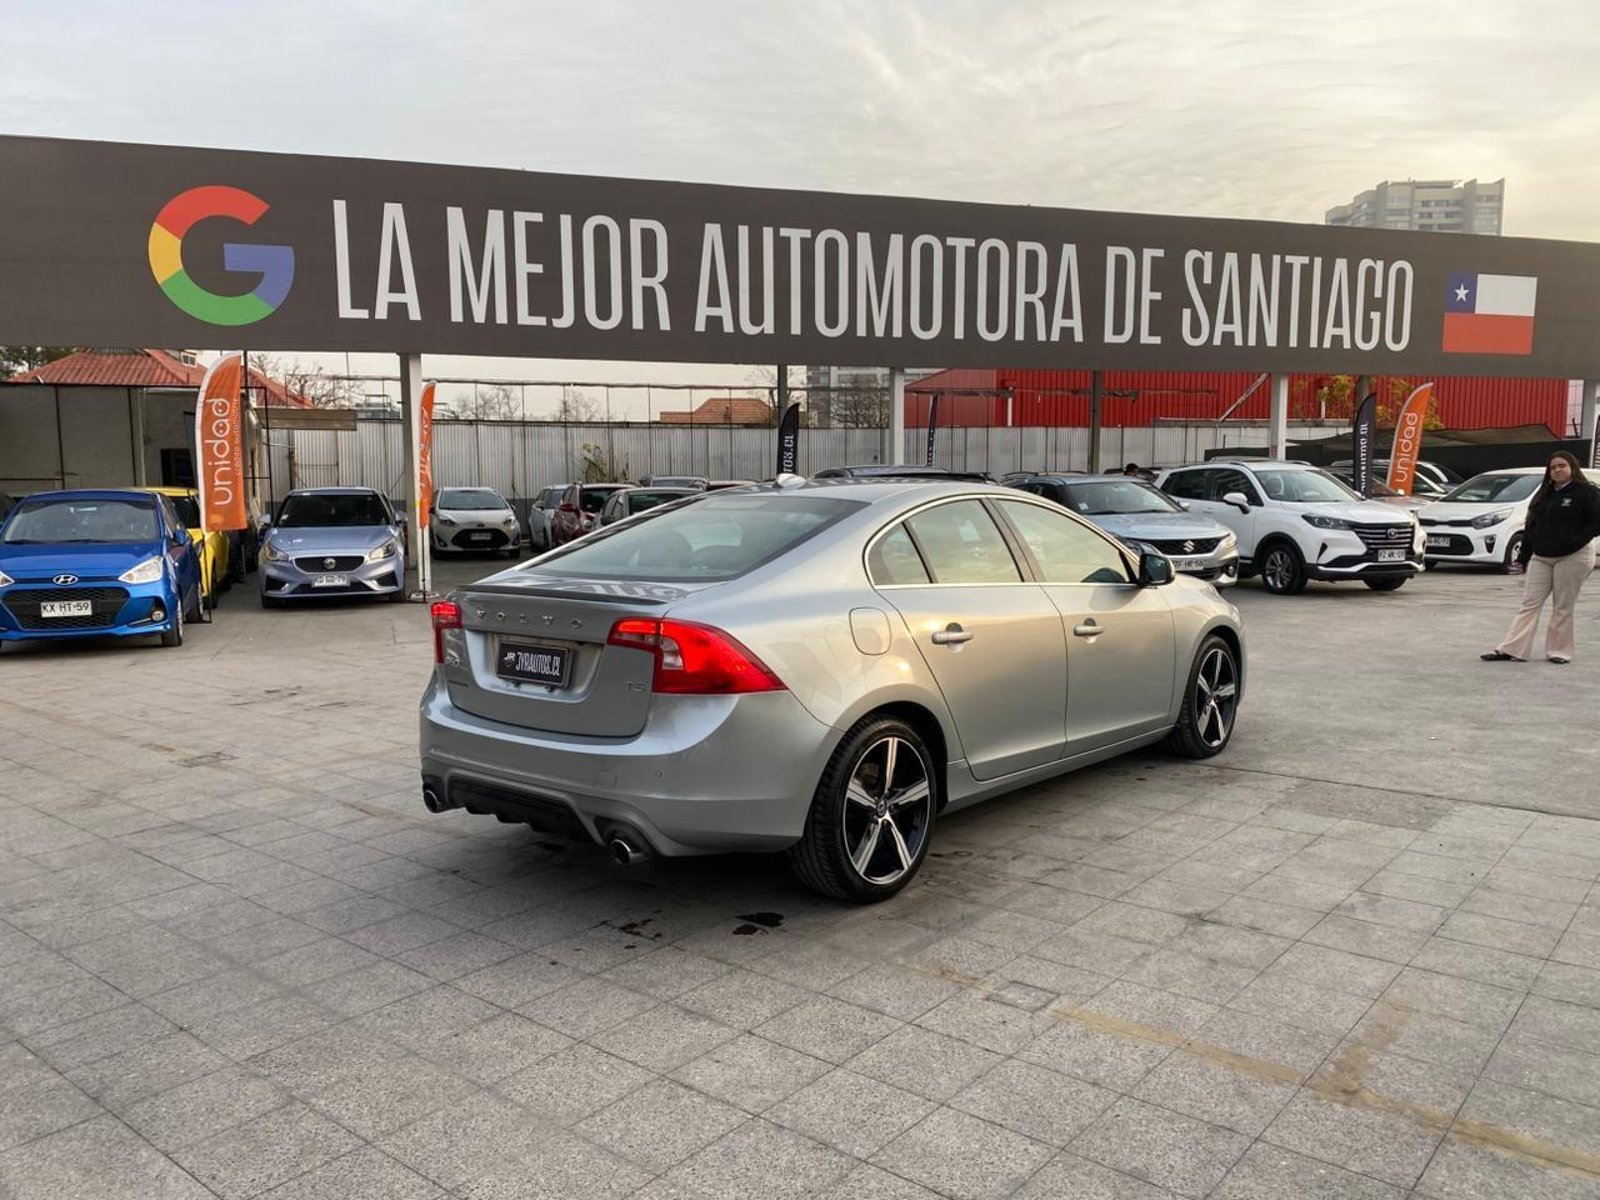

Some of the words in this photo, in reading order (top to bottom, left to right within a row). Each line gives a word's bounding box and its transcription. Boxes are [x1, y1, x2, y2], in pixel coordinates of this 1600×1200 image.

[333, 199, 421, 321] LA
[446, 206, 671, 330] MEJOR
[694, 222, 1084, 342] AUTOMOTORA
[1103, 246, 1164, 344] DE
[1181, 249, 1414, 351] SANTIAGO
[204, 397, 232, 505] unidad
[1395, 412, 1418, 482] unidad
[476, 609, 582, 629] VOLVO
